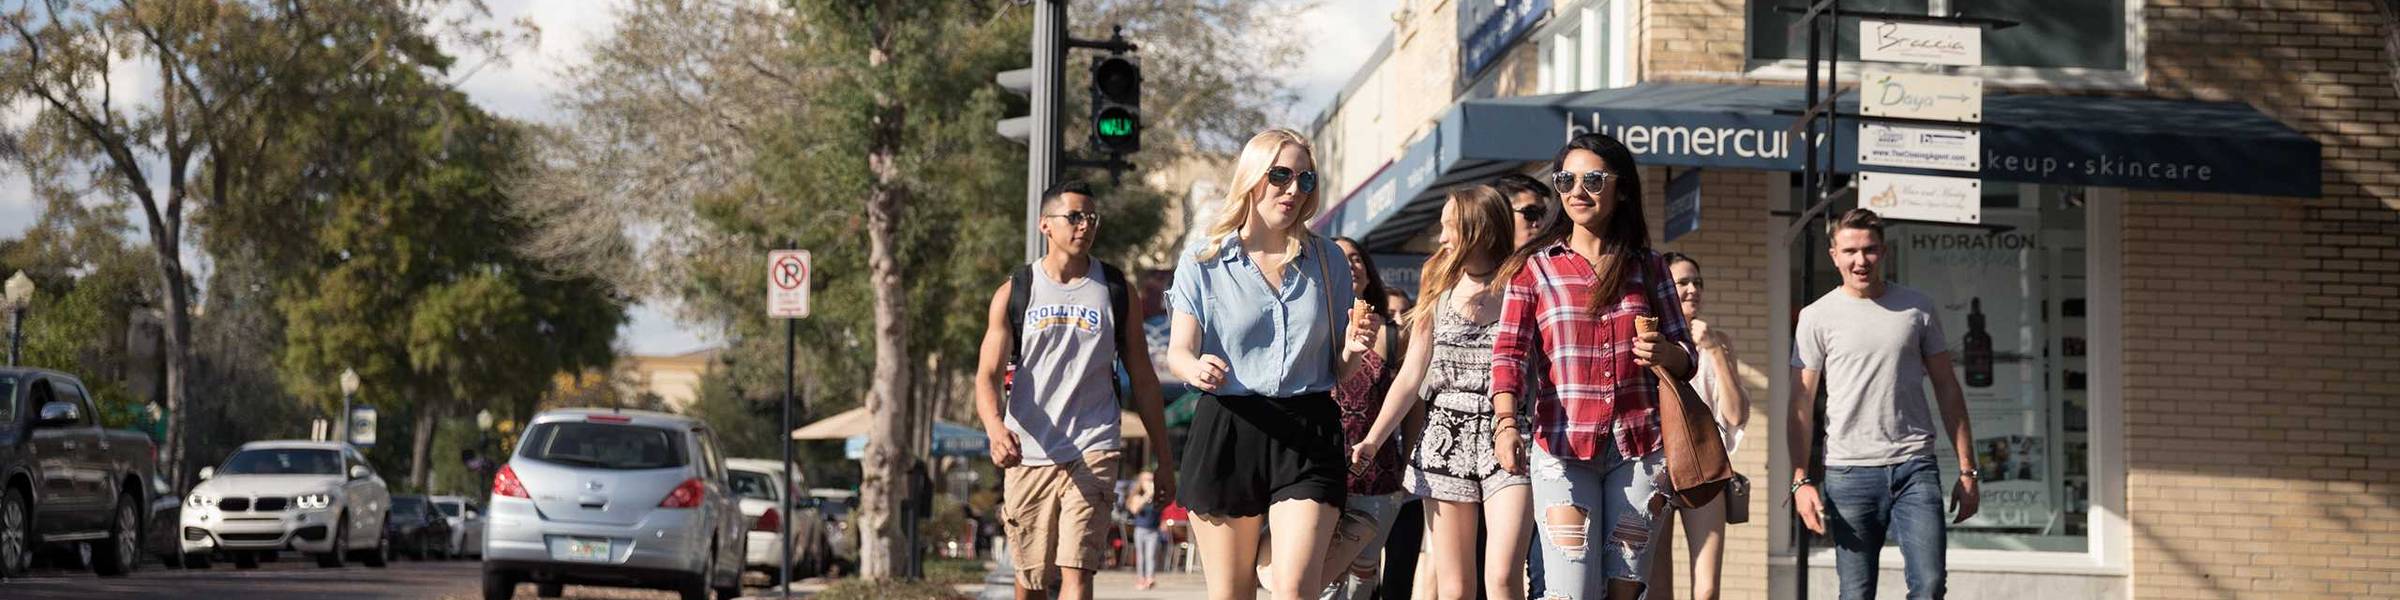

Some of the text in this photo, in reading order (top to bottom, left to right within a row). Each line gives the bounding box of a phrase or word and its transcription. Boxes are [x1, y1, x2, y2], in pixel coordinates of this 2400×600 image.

[1100, 118, 1132, 136] WALK
[1979, 149, 2213, 181] keup skincare
[1911, 233, 2036, 249] HYDRATION
[1028, 305, 1099, 325] ROLLINS
